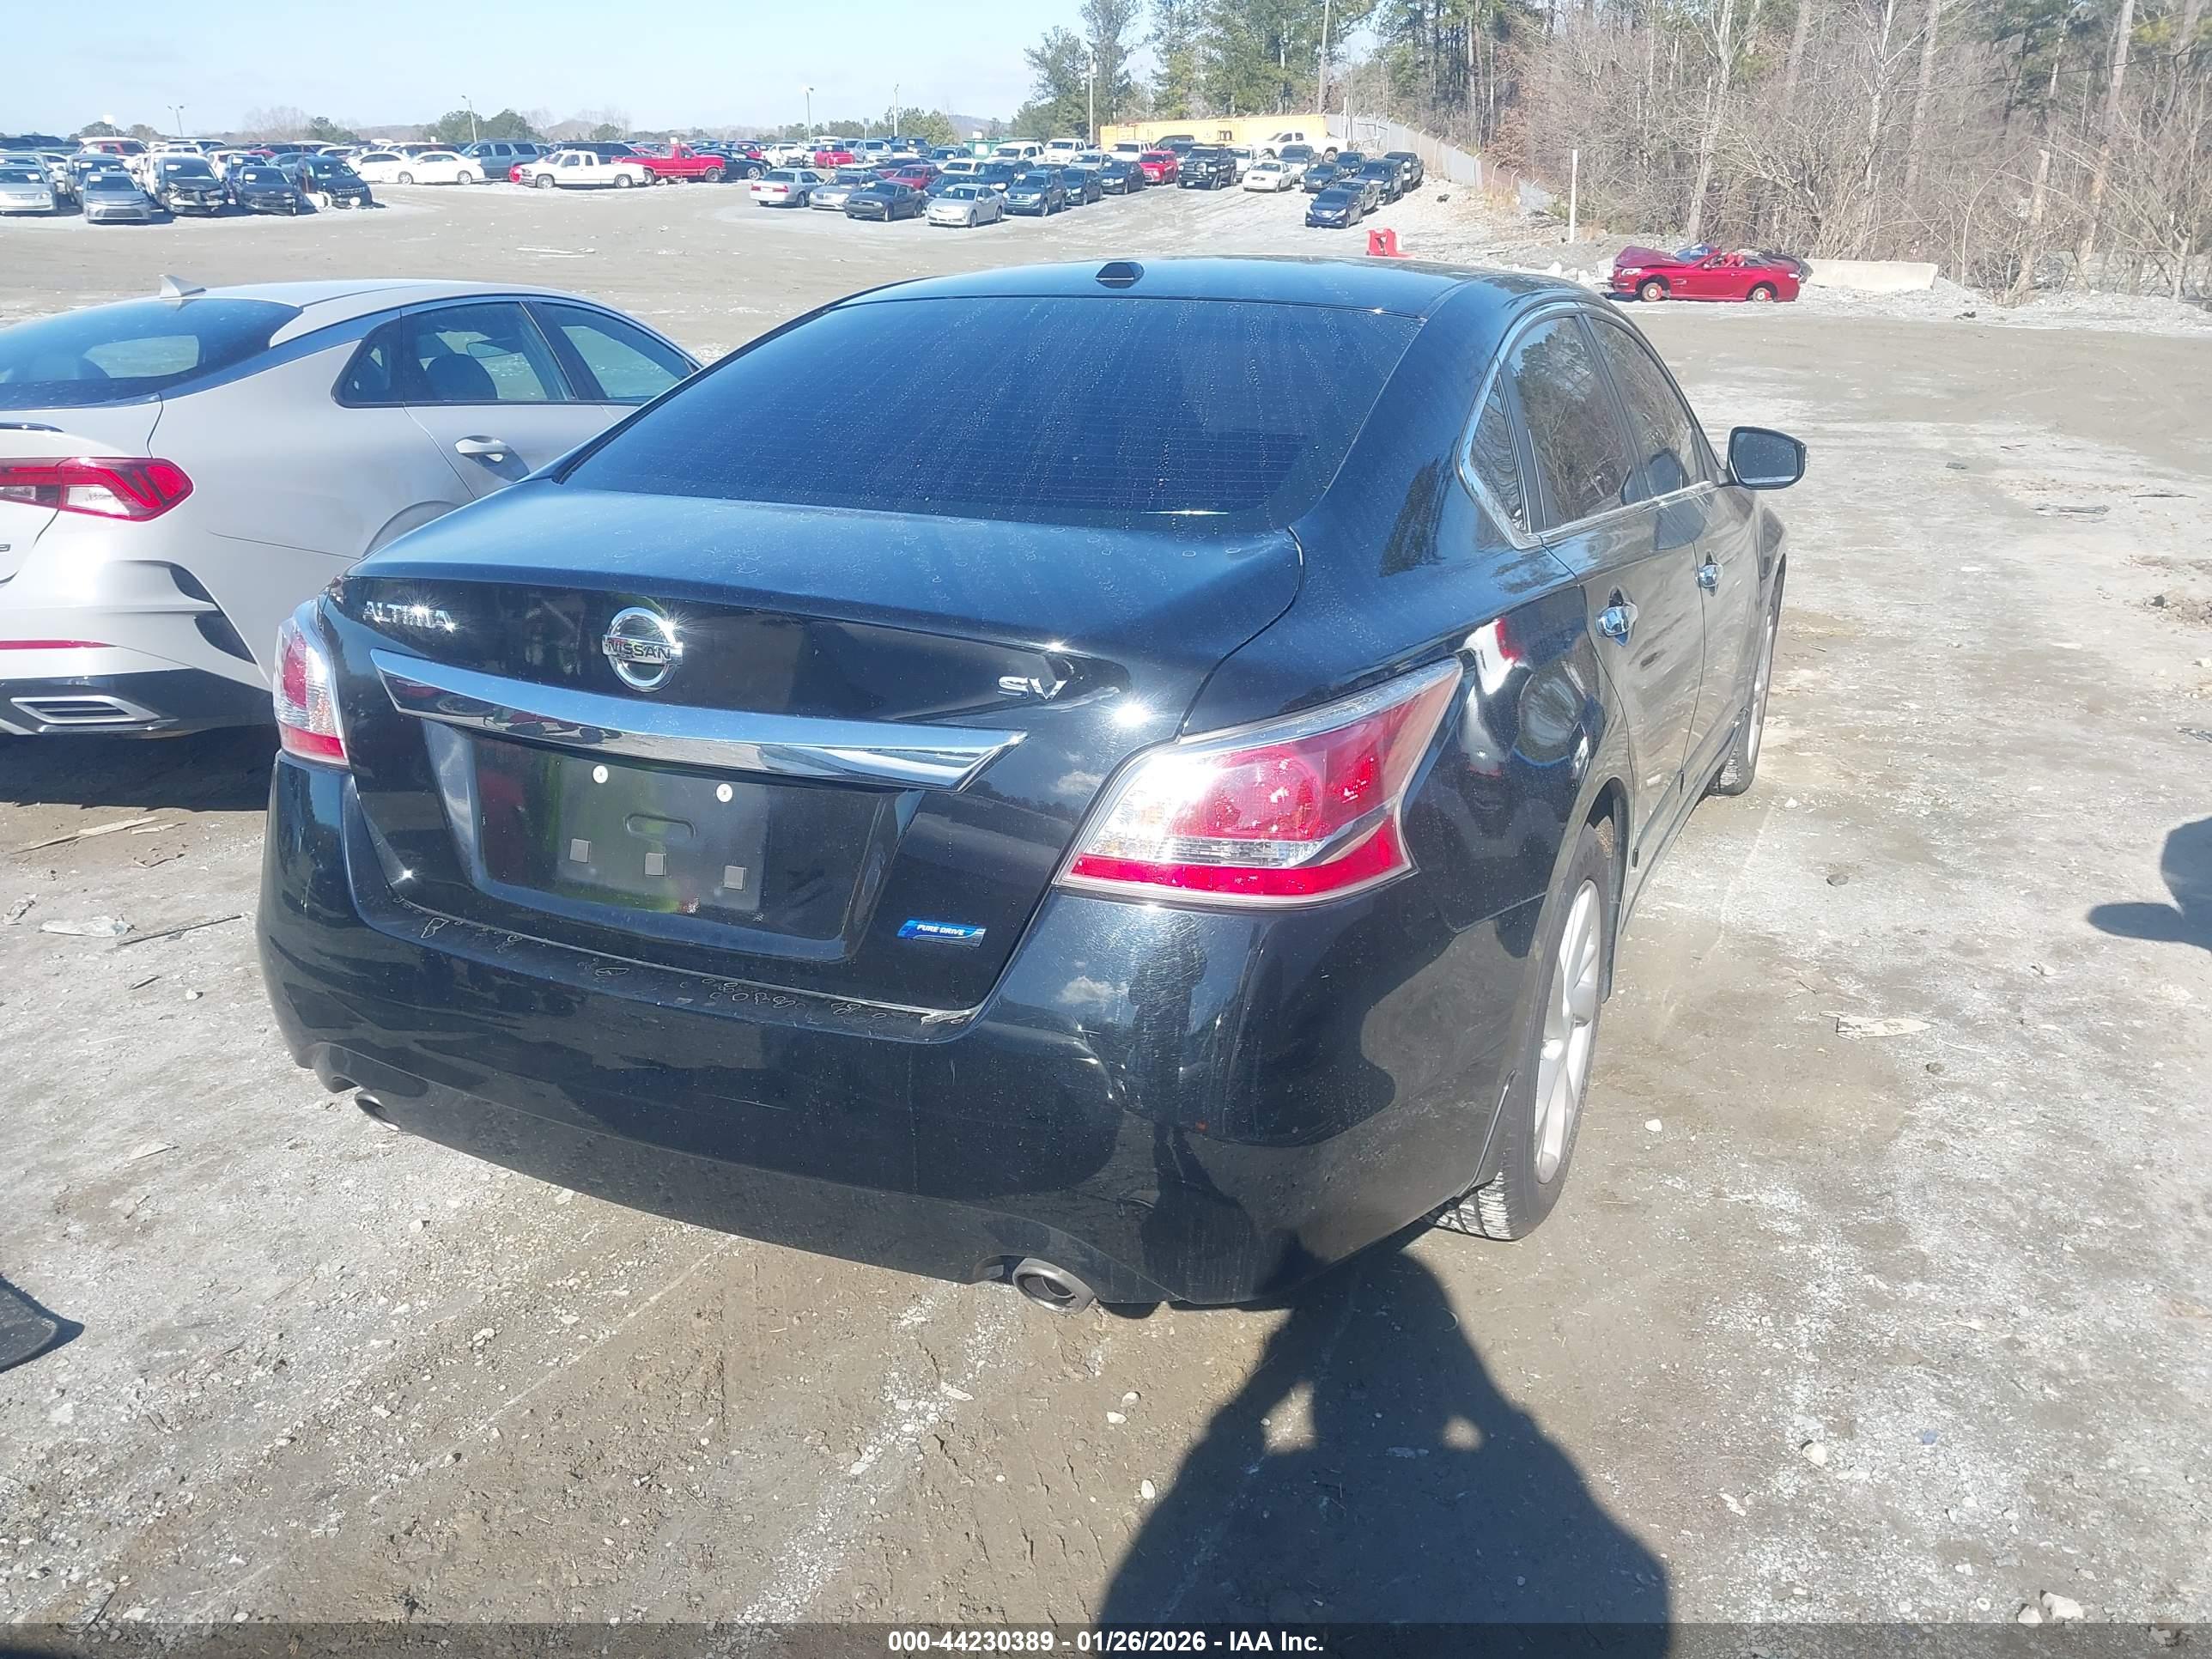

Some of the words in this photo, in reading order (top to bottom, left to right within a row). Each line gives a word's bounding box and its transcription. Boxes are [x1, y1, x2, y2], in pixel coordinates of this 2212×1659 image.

[607, 640, 671, 660] NISSAN
[997, 675, 1068, 700] SV
[916, 924, 939, 933] PURE
[939, 927, 966, 935] DRIVE
